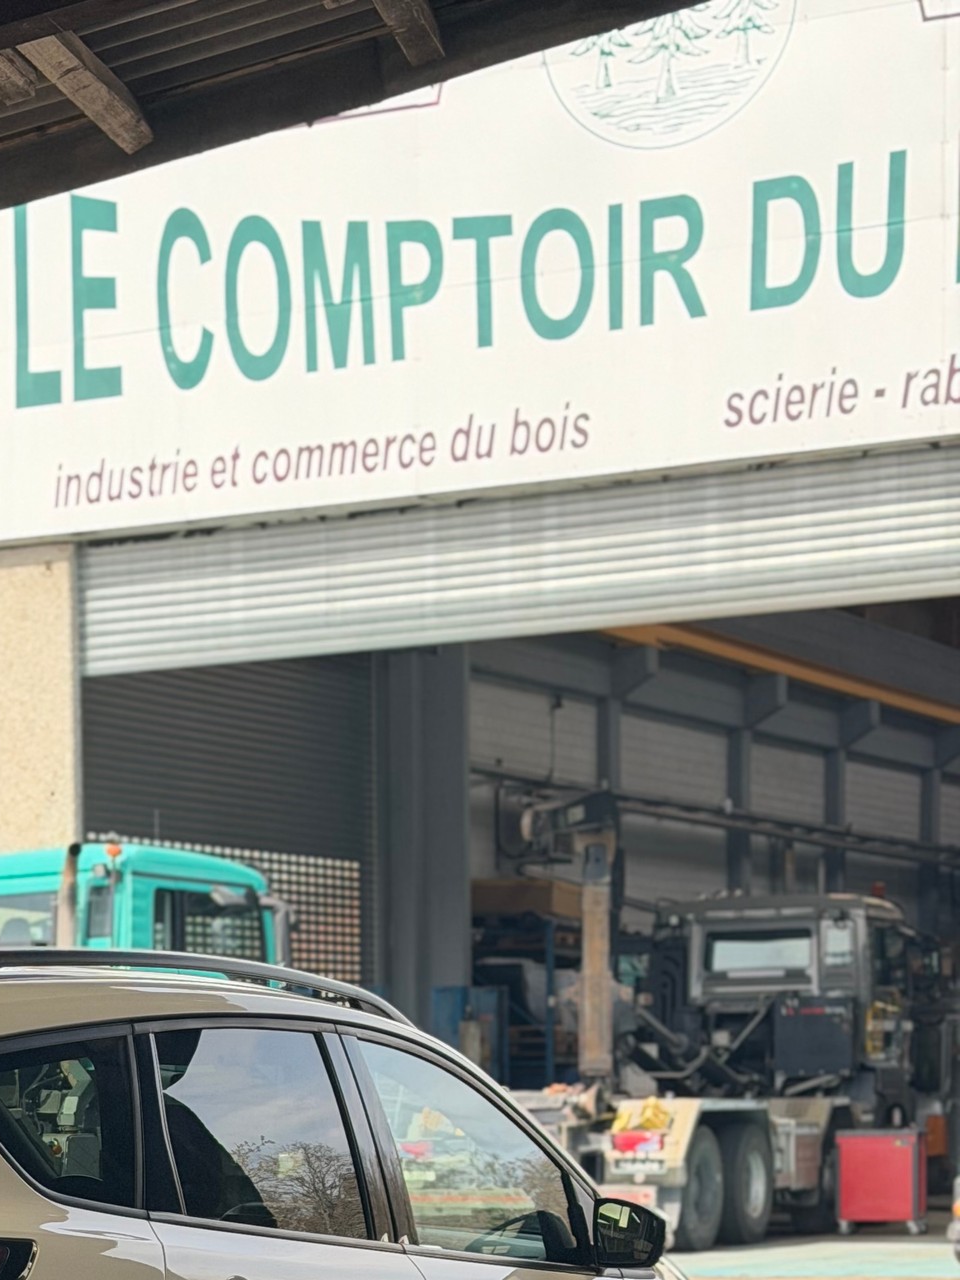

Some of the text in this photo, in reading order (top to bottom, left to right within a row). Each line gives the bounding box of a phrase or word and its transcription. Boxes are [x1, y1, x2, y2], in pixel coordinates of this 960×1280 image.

[12, 194, 123, 409] LE
[156, 194, 708, 390] COMPTOIR
[749, 149, 908, 312] DU
[723, 366, 859, 428] scierie
[53, 402, 591, 508] industrie et commerce du bois
